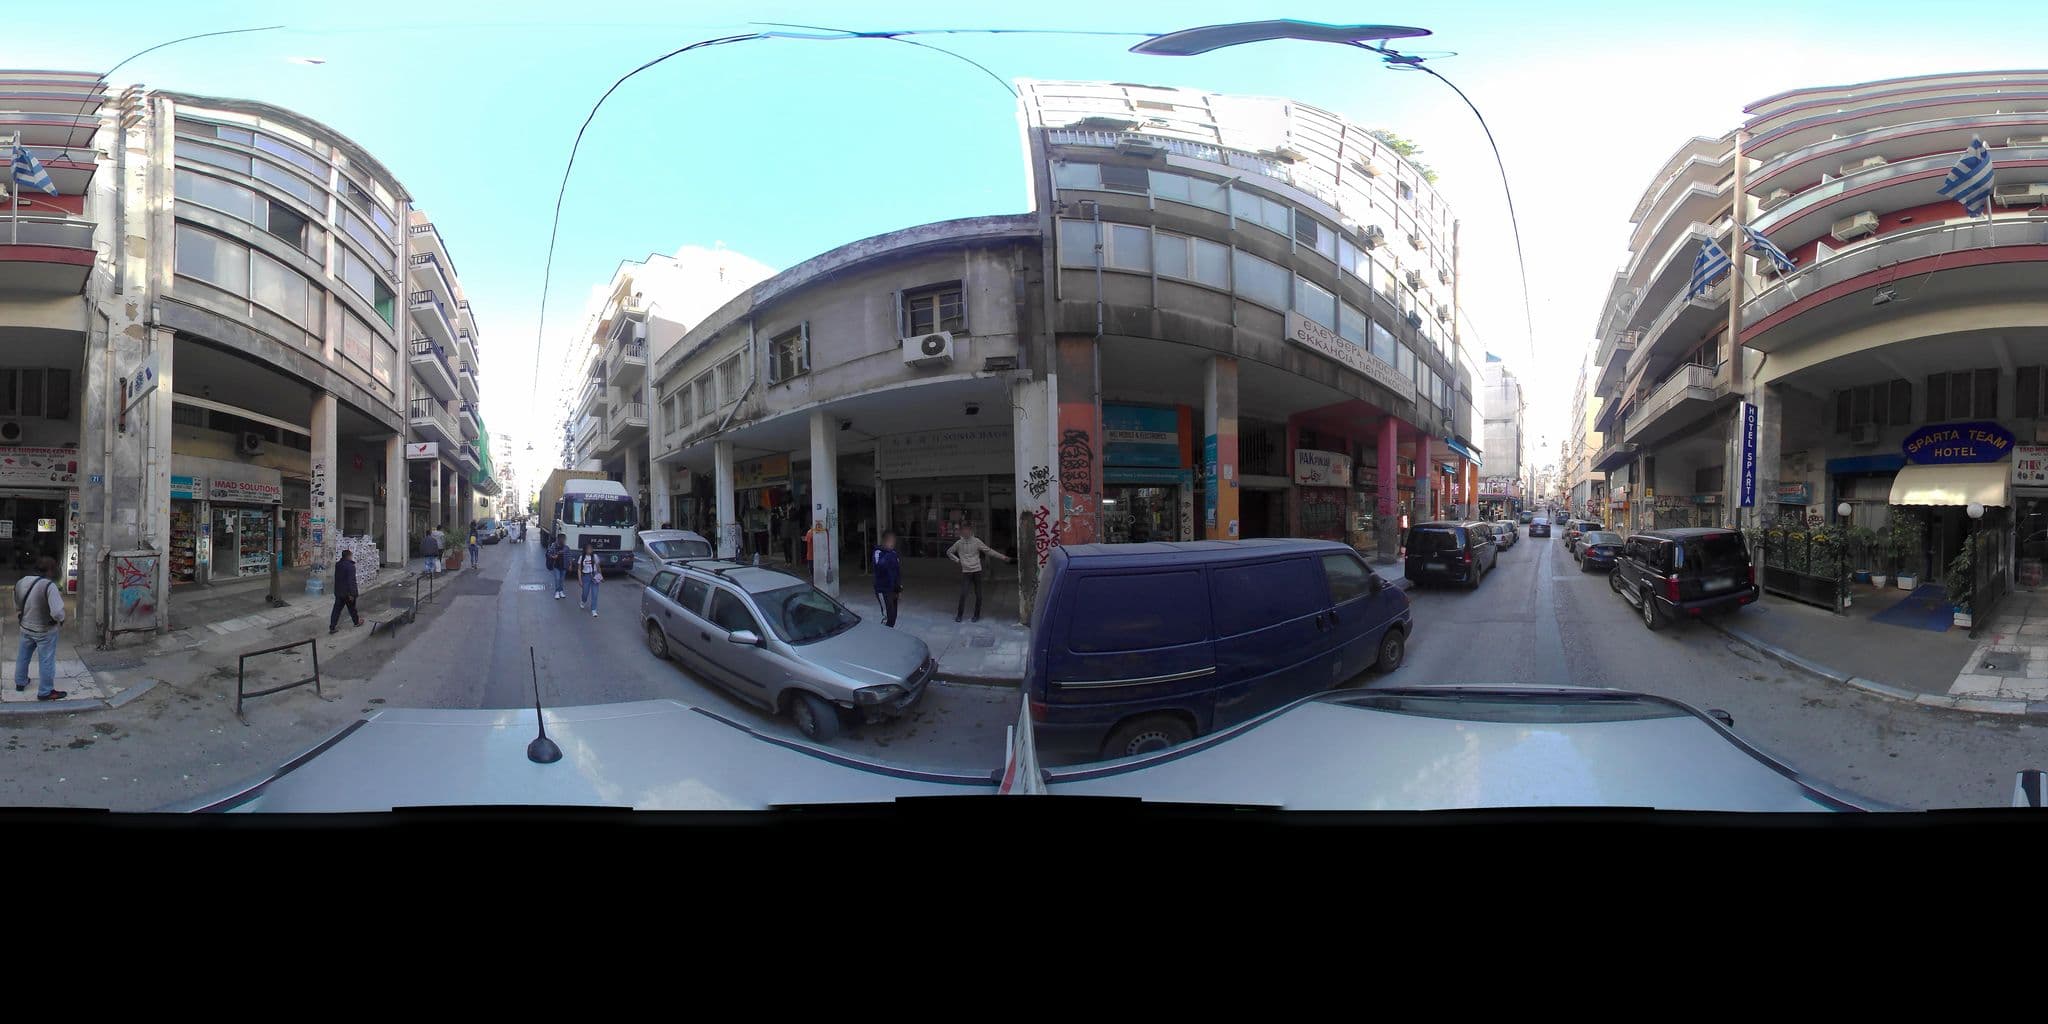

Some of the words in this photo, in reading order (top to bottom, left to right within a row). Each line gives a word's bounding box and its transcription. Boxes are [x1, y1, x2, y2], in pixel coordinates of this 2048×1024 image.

[1747, 407, 1755, 448] HOTEL
[1908, 430, 1960, 454] SPARTA
[1968, 430, 2008, 450] TEAM
[1934, 446, 1978, 457] HOTEL
[214, 480, 237, 490] IMAD
[239, 482, 280, 494] SOLUTIONS
[1745, 452, 1753, 504] SPARTA
